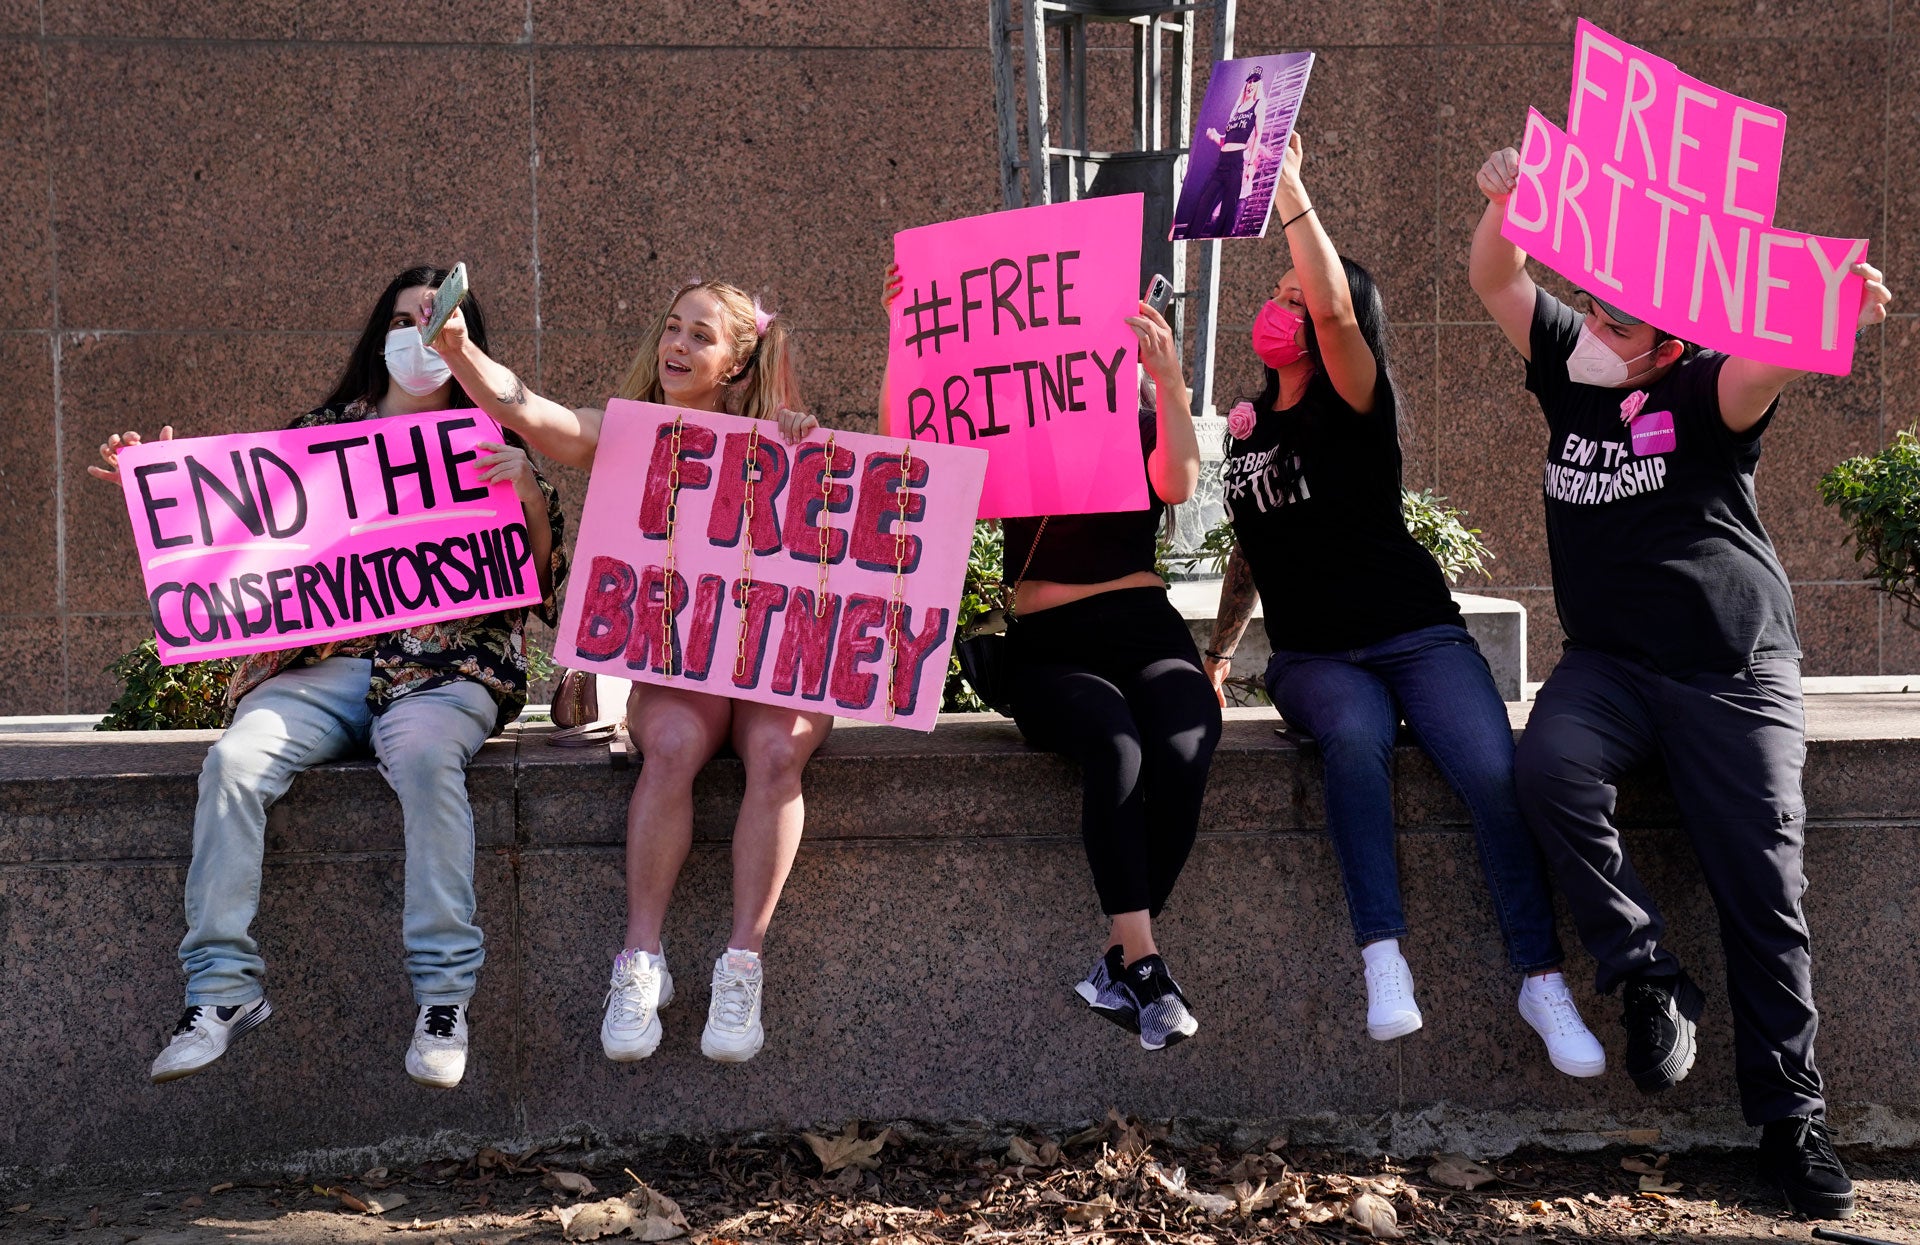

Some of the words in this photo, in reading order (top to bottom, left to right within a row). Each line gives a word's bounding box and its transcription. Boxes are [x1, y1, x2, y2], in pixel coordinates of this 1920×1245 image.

[1572, 30, 1779, 224] FREE
[1507, 113, 1867, 351] BRITNEY
[903, 250, 1081, 359] #FREE
[907, 346, 1127, 444] BRITNEY
[1602, 440, 1628, 468] TH
[133, 446, 308, 549] END
[308, 417, 489, 519] THE
[638, 421, 930, 574] FREE
[148, 522, 531, 647] CONSERVATORSHIP
[575, 555, 949, 716] BRITNEY
